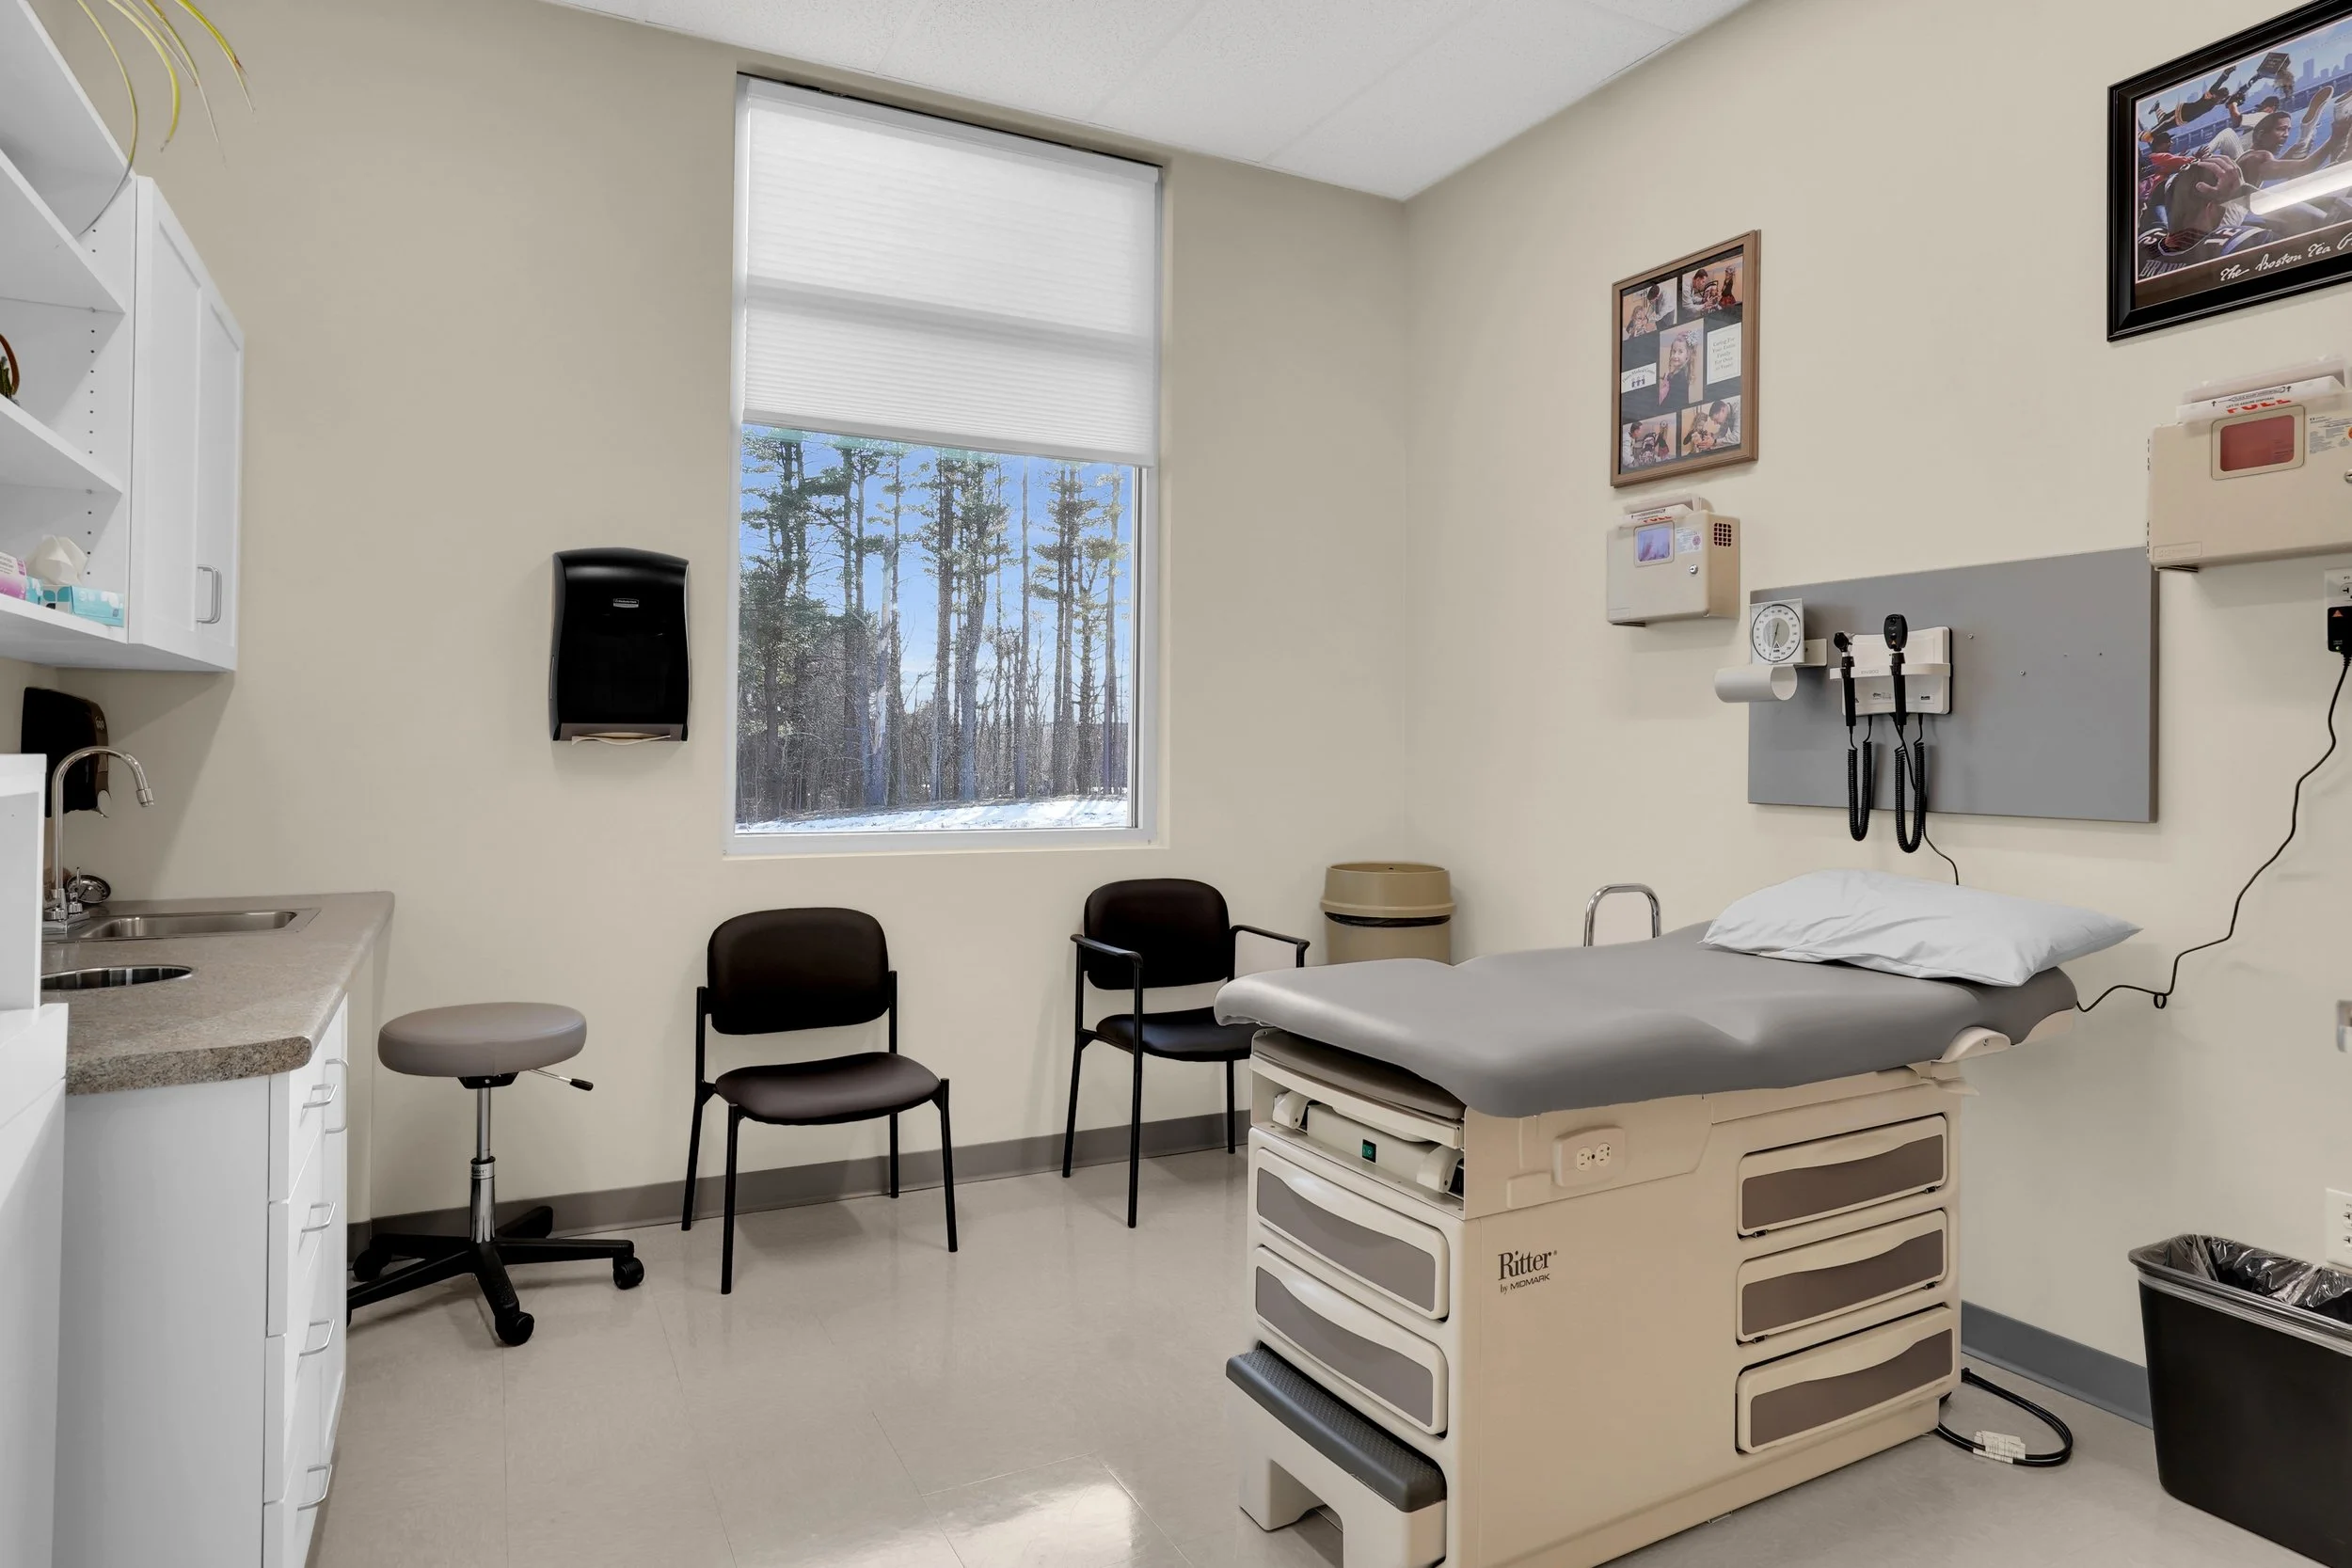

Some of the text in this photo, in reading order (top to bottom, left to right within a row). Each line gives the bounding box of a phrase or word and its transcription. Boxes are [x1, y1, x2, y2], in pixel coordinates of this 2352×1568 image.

[2220, 264, 2249, 281] The
[2255, 253, 2302, 271] Boston
[2308, 243, 2331, 257] Tea
[1498, 1250, 1552, 1281] Ritter
[1501, 1273, 1550, 1295] by MIDMARK
